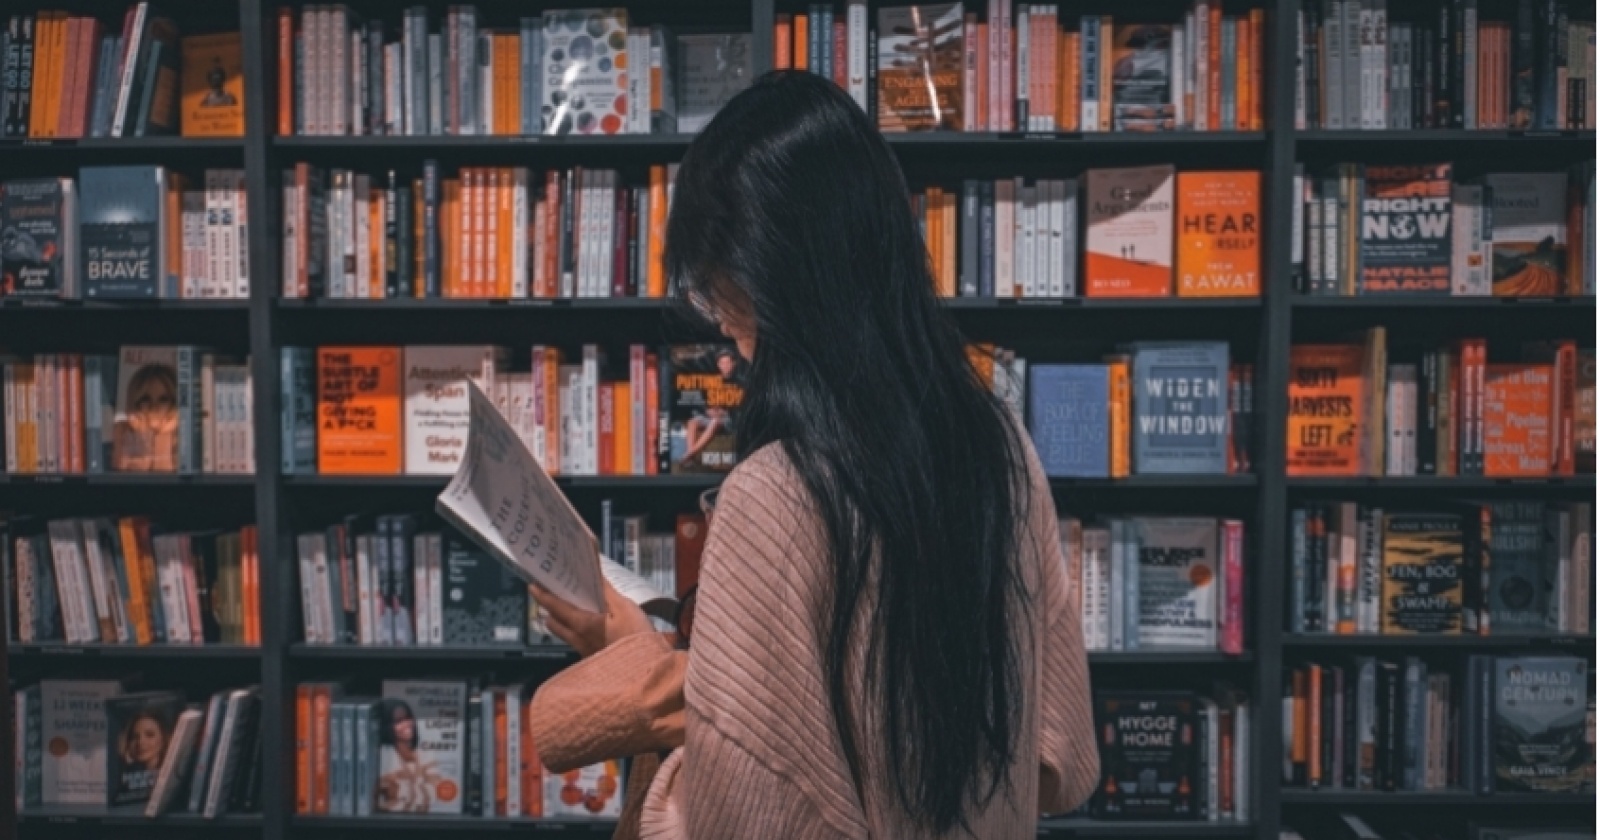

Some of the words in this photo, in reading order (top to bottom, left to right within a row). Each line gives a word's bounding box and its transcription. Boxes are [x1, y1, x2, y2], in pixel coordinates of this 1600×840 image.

[1363, 198, 1450, 212] RIGHT
[1184, 213, 1256, 236] HEAR
[1363, 213, 1450, 240] NOW
[88, 261, 150, 280] BRAVE
[1184, 272, 1255, 289] RAWAT
[322, 353, 352, 364] THE
[322, 366, 380, 379] SUBTLE
[322, 380, 352, 392] ART
[357, 380, 379, 392] OF
[424, 383, 464, 402] Span
[1145, 377, 1219, 398] WIDEN
[1172, 401, 1194, 413] THE
[1290, 395, 1352, 417] ARVESTS
[1139, 415, 1225, 435] WINDOW
[425, 435, 462, 448] Gloria
[1301, 424, 1333, 447] LEFT
[428, 451, 459, 463] Mark
[1425, 565, 1457, 578] BOG
[1510, 671, 1571, 685] NOMAD
[1502, 686, 1578, 701] CENTURY
[426, 720, 458, 729] LIGHT
[1119, 715, 1177, 731] HYGGE
[1123, 733, 1174, 746] HOME
